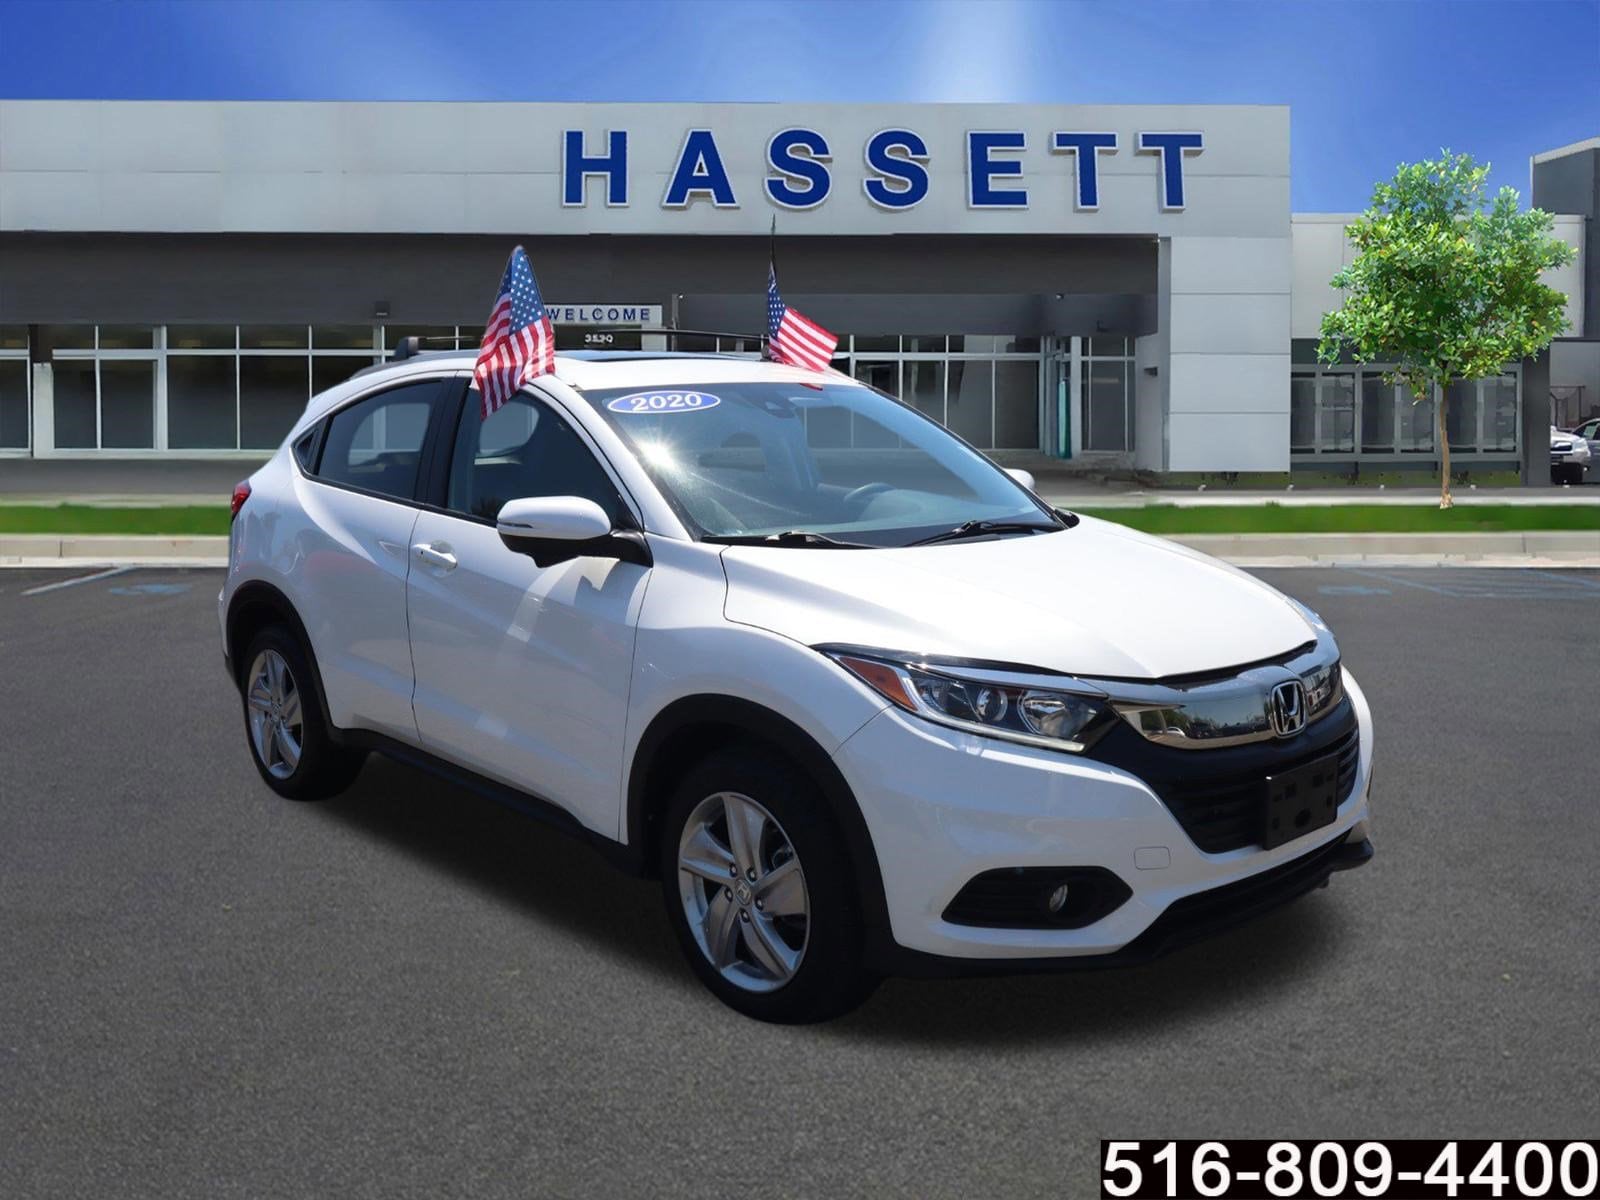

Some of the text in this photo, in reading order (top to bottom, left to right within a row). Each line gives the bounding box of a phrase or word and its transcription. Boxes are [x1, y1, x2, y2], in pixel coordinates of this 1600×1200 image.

[563, 129, 1203, 209] HASSETT
[546, 308, 651, 320] WELCOME
[631, 393, 702, 412] 2020
